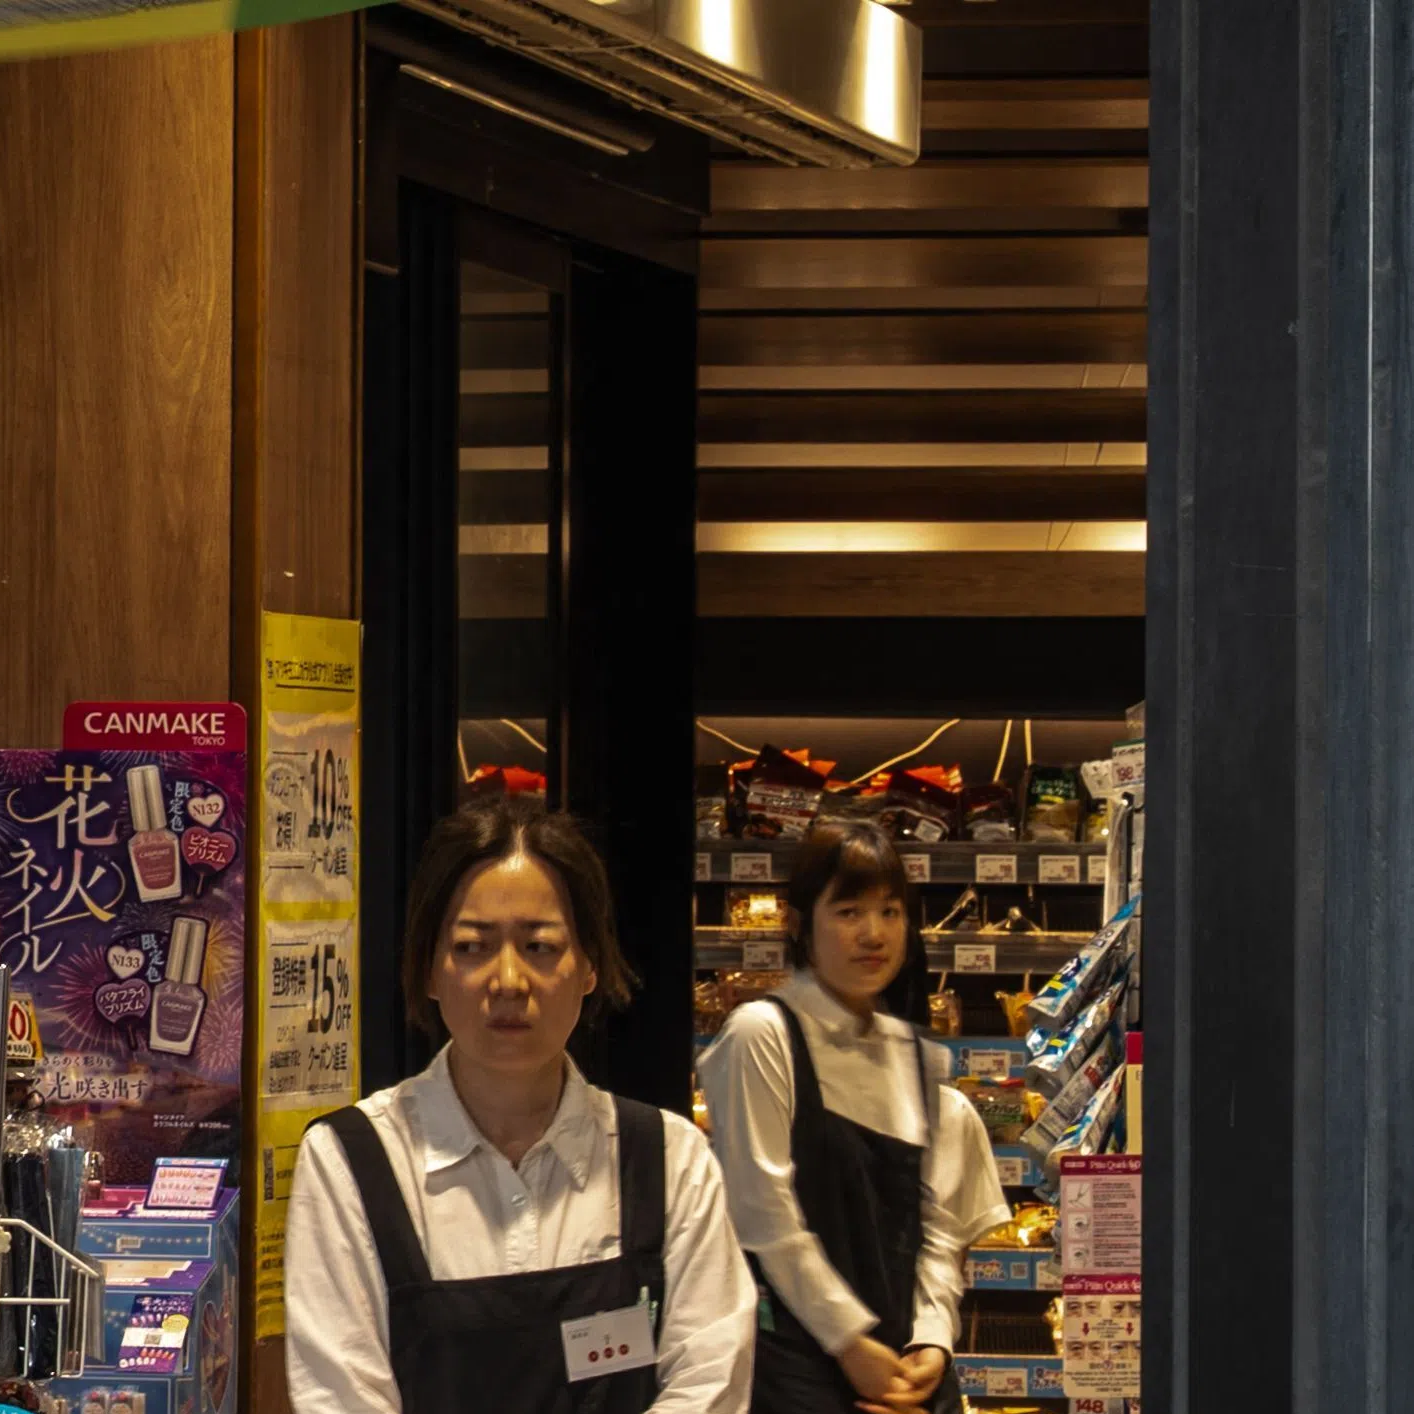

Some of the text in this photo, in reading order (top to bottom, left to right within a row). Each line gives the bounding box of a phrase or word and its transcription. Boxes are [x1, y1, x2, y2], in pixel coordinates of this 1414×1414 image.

[83, 711, 226, 735] CANMAKE
[192, 736, 226, 746] TOKYO
[170, 781, 191, 832] 限定色
[191, 801, 221, 817] N132
[44, 764, 118, 922] 花火
[111, 951, 142, 969] N133
[141, 933, 167, 983] 限定色
[335, 1003, 352, 1031] OFF
[1075, 1398, 1104, 1414] 148
